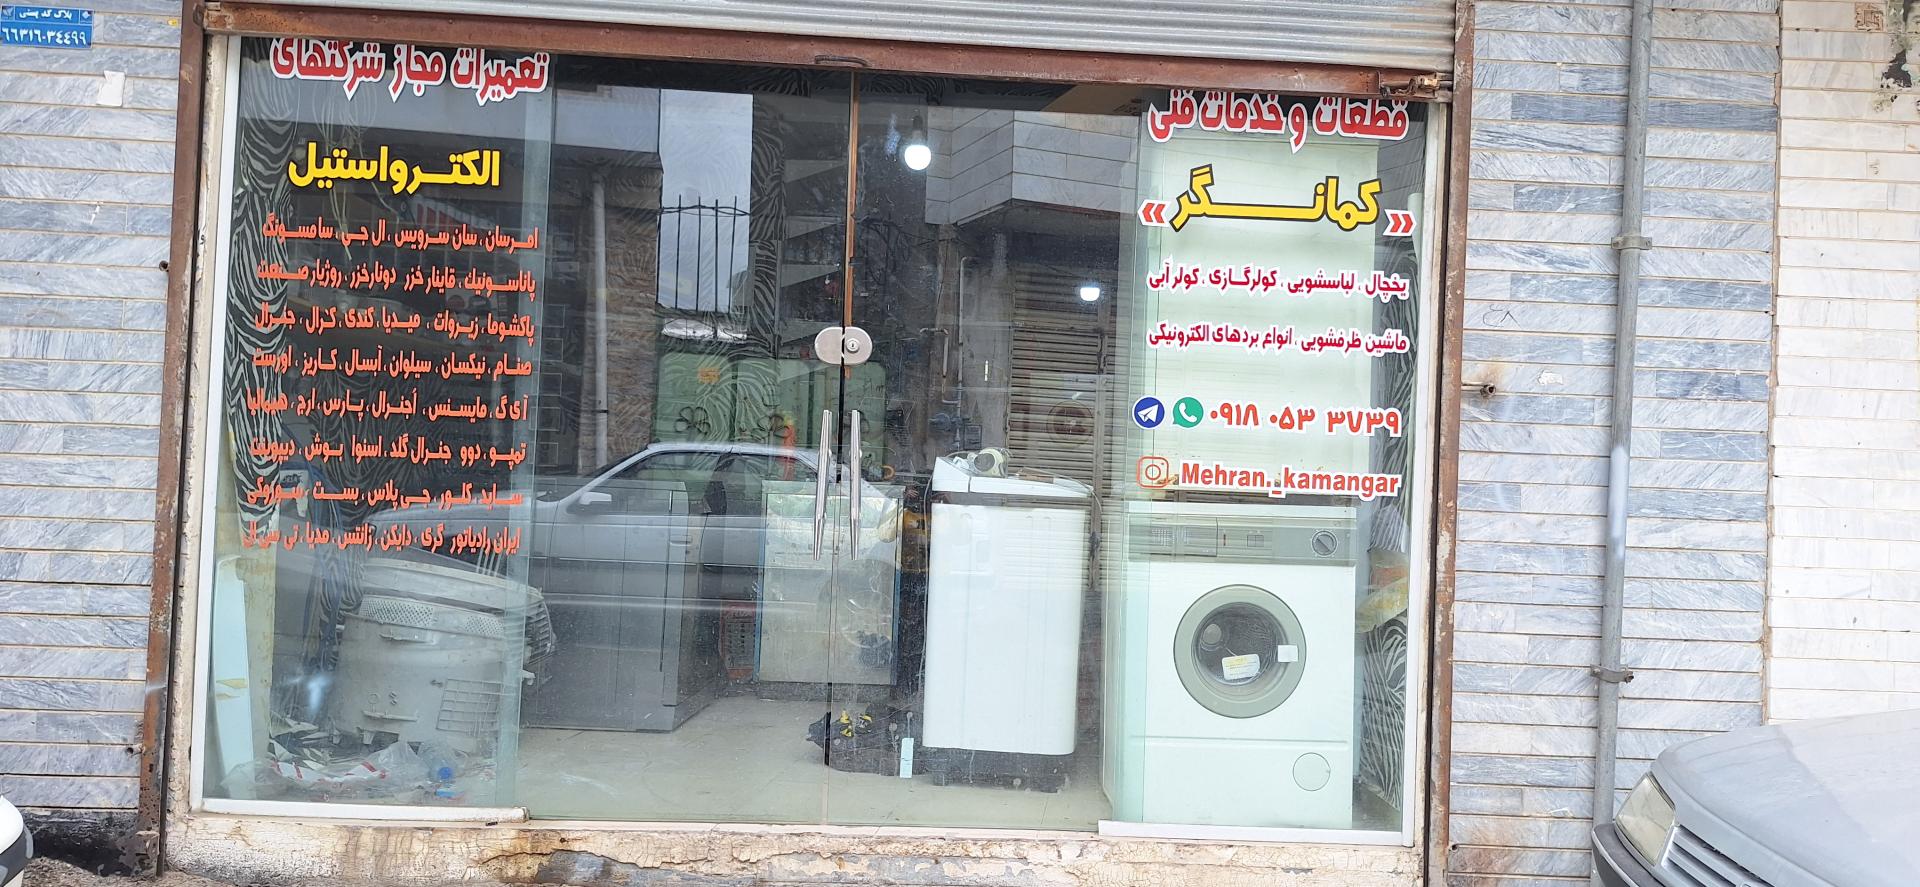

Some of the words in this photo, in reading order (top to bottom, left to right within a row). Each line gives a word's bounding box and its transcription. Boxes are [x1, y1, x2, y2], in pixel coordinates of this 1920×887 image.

[271, 38, 385, 101] شرکتهای
[389, 44, 446, 102] مجاز
[451, 46, 549, 106] تعمیرات
[1148, 89, 1197, 143] فنی
[1200, 91, 1287, 134] خدمات
[1313, 97, 1409, 140] قطعات
[1288, 102, 1308, 153] و
[288, 142, 500, 195] الکترواستیل
[263, 211, 333, 243] سامسونگ
[342, 225, 368, 246] جی
[394, 229, 449, 250] سرویس
[452, 223, 477, 251] سان
[485, 225, 539, 254] امرسان
[257, 259, 309, 281] صنعت
[404, 265, 424, 291] خزر
[1149, 262, 1170, 289] آبی
[1172, 266, 1199, 289] کولر
[1288, 270, 1355, 294] لباسشویی
[1365, 273, 1407, 299] یخچال
[255, 302, 296, 331] جنرال
[382, 306, 421, 333] میدیا
[487, 312, 535, 346] پاکشوما
[1149, 323, 1209, 347] الکترونیکی
[1262, 326, 1292, 350] انواع
[1301, 328, 1361, 353] ظرفشویی
[1365, 331, 1407, 353] ماشین
[253, 345, 292, 374] اورست
[345, 345, 382, 376] آبسال
[389, 350, 432, 379] سیلوان
[441, 352, 486, 379] نیکسان
[493, 353, 532, 381] صنام
[246, 387, 288, 416] هیمالیا
[296, 387, 316, 416] ارج
[323, 389, 364, 422] پارس
[304, 432, 344, 463] بوش
[351, 434, 382, 464] اسنوا
[390, 433, 408, 458] گلد
[410, 436, 452, 466] جنرال
[313, 481, 359, 505] بست
[367, 479, 399, 511] پلاس
[400, 488, 431, 509] جی
[421, 523, 444, 553] گری
[450, 526, 491, 557] رادیاتور
[493, 526, 521, 555] ایران
